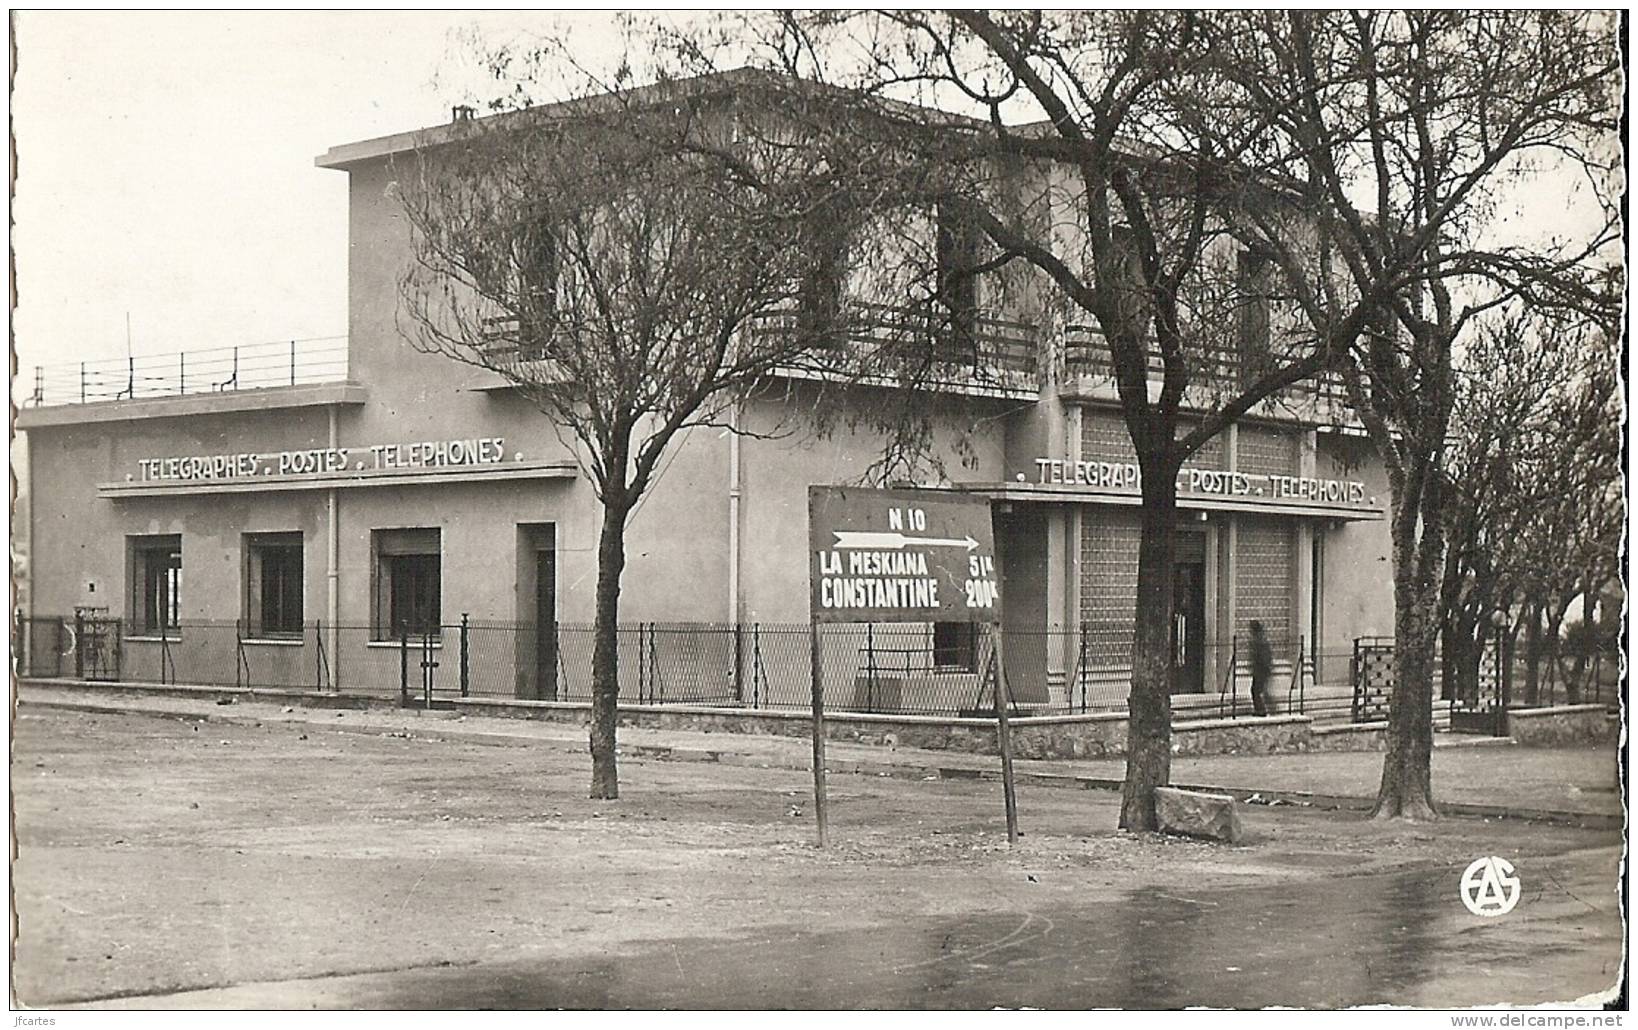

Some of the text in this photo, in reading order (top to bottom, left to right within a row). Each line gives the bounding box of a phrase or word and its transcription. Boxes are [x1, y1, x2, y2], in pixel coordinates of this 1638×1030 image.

[139, 437, 504, 481] TELEGRAPHES POSTES TELEPHONES
[1035, 458, 1365, 504] TELEGRAP POSTES TELEPHONES
[888, 508, 926, 532] N 10
[819, 550, 843, 575] LA
[849, 551, 928, 576] MESKIANA
[821, 577, 940, 608] CONSTANTINE
